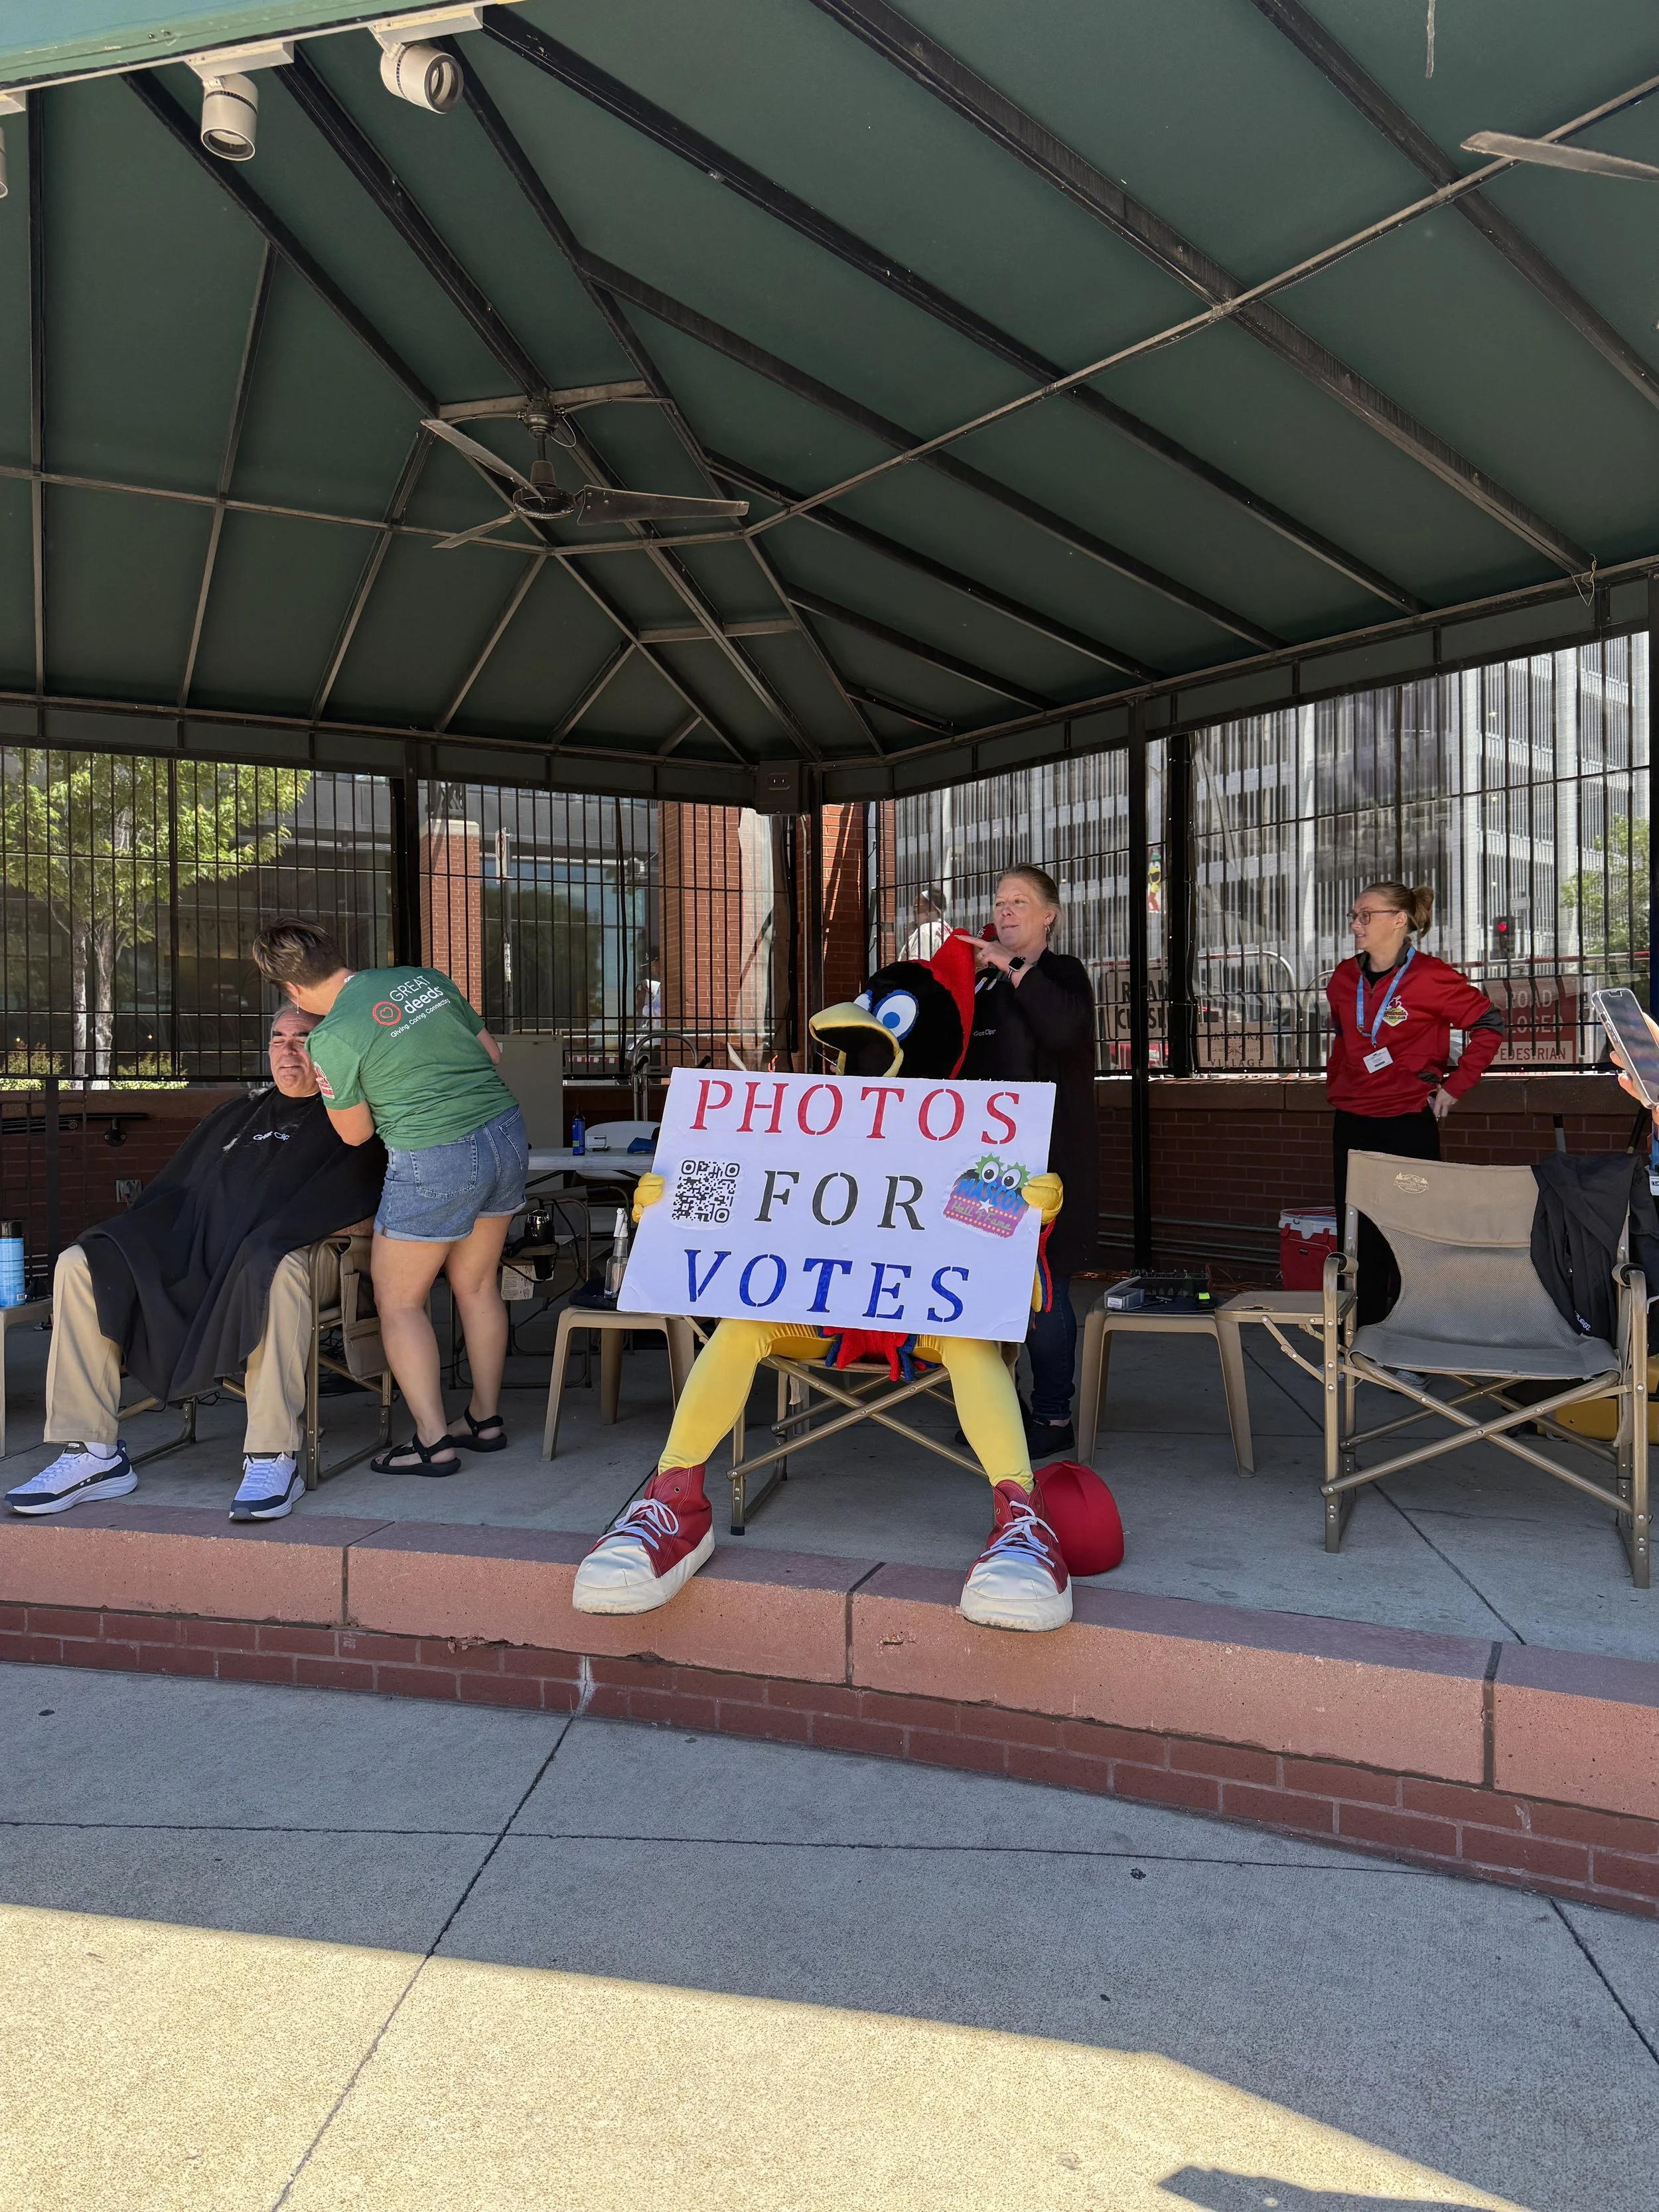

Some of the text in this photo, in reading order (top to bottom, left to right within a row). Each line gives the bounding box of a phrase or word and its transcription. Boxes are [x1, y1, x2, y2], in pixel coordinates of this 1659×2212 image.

[390, 975, 431, 1001] GREAT
[404, 986, 444, 1014] deeds
[1496, 1047, 1566, 1061] EDESTRIAN
[689, 1078, 1020, 1145] PHOTOS
[755, 1170, 925, 1230] FOR
[955, 1178, 1026, 1215] MASCOT
[684, 1249, 970, 1323] VOTES
